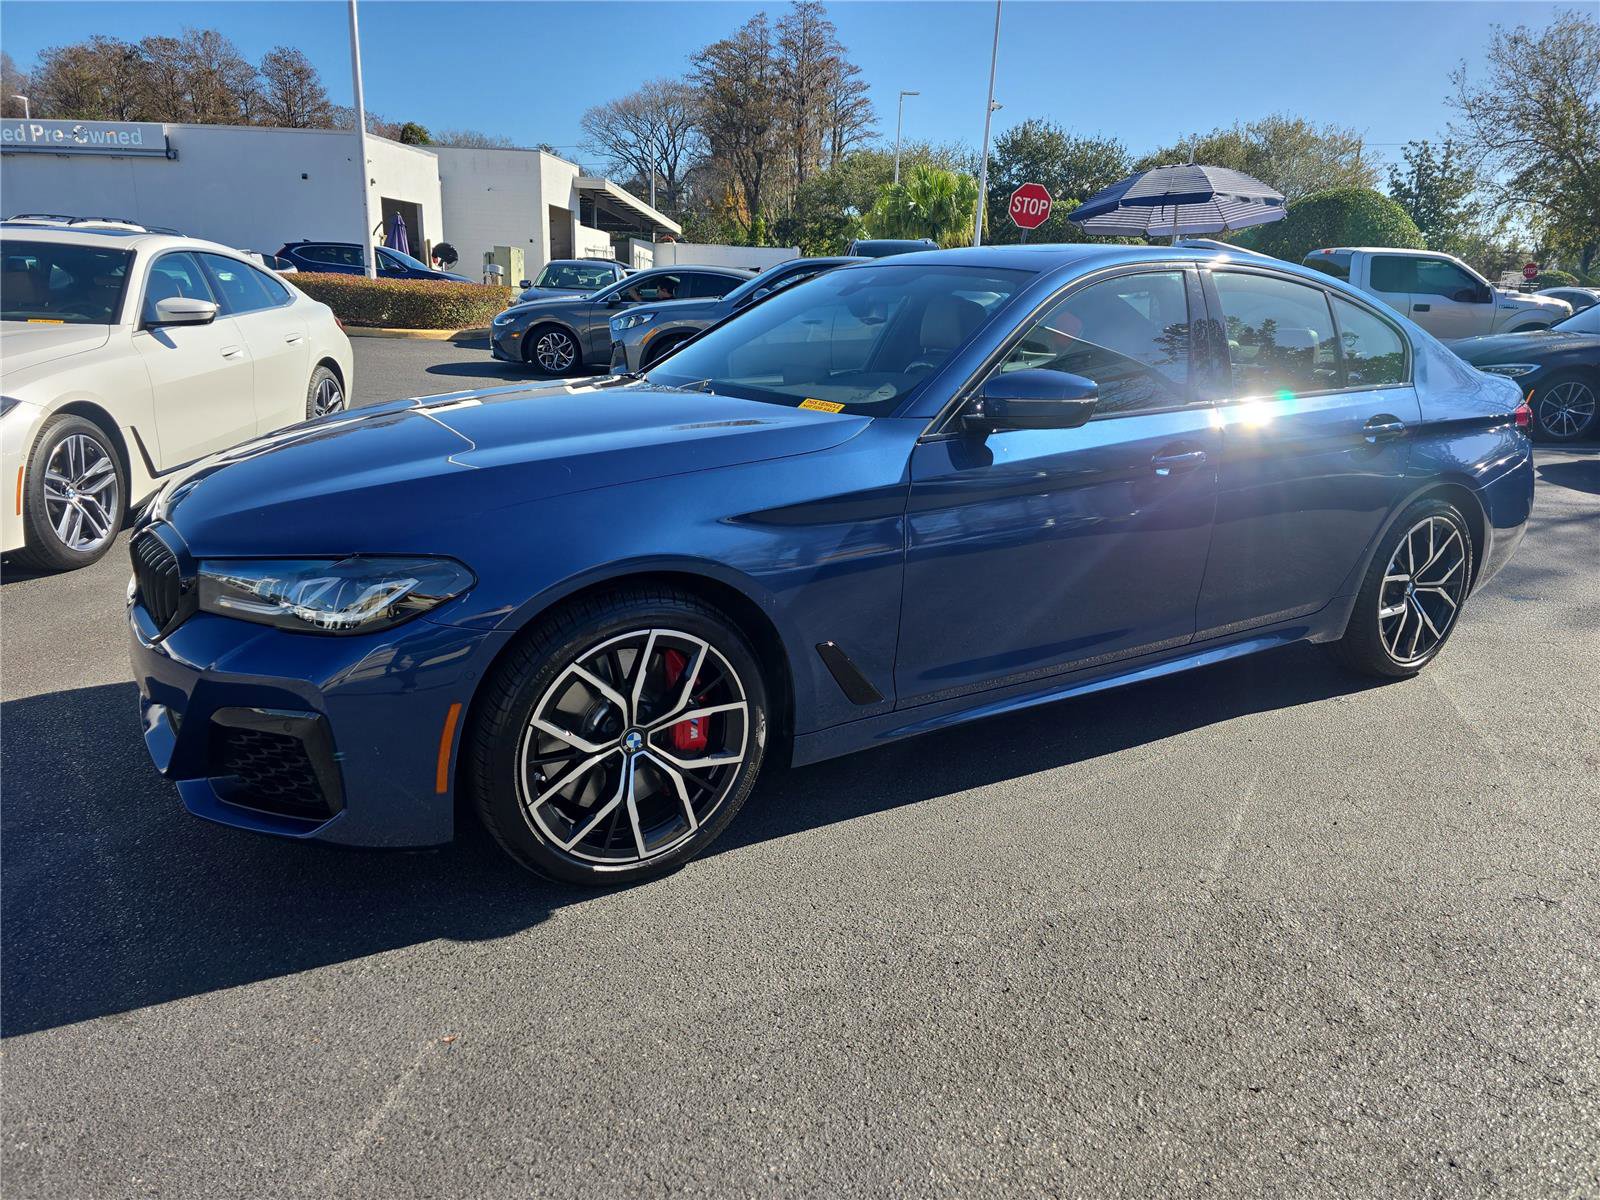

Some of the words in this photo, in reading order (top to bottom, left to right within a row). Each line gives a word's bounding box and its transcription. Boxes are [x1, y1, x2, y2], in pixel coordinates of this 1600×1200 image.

[30, 124, 143, 145] Pre-Owned
[1012, 196, 1048, 215] STOP
[1523, 267, 1537, 275] STOP
